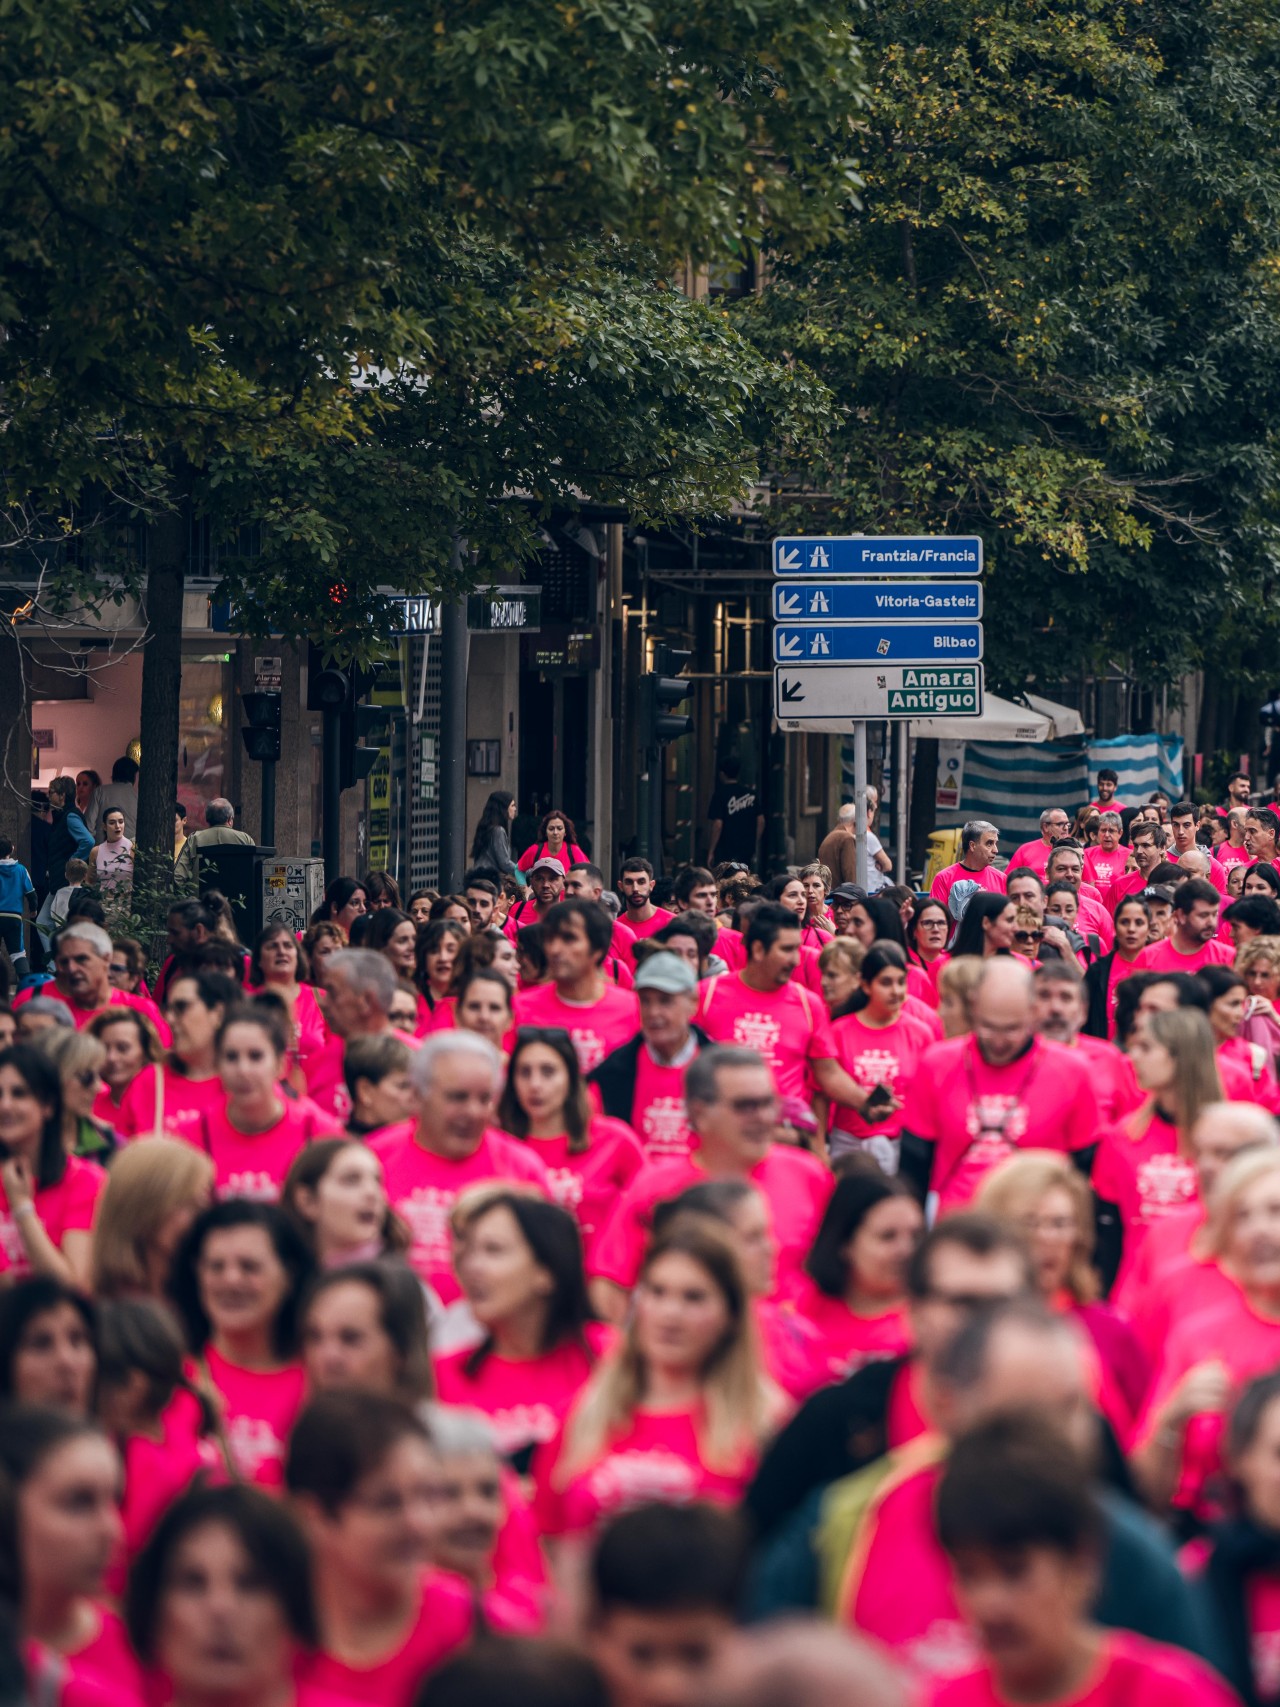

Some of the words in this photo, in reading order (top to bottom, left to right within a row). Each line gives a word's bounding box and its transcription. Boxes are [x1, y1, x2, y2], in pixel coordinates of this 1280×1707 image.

[862, 550, 975, 562] Frantzia/Francia
[875, 595, 976, 607] Vitoria-Gasteiz
[933, 636, 976, 648] Bilbao
[904, 670, 974, 687] Amara
[891, 690, 974, 712] Antiguo
